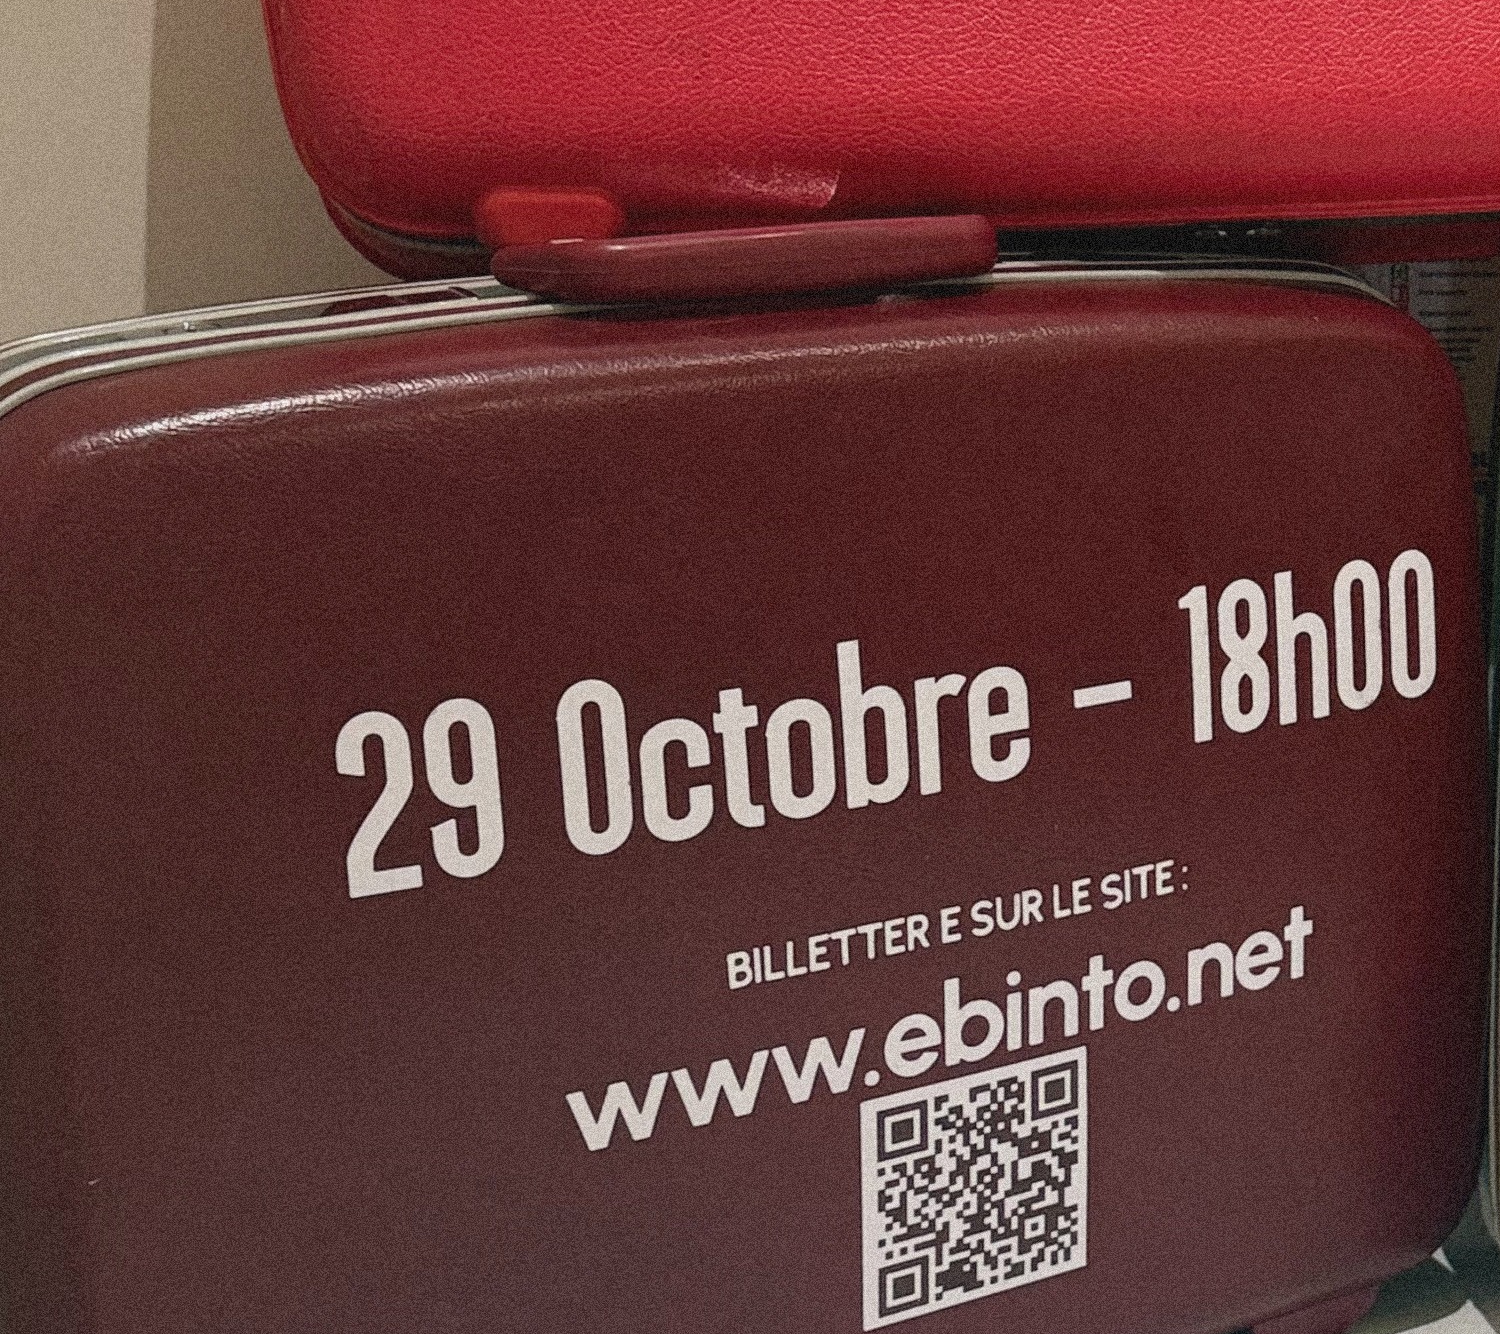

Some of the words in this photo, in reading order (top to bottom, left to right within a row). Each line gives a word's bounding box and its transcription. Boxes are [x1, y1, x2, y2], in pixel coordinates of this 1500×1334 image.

[336, 699, 504, 898] 29
[556, 640, 1030, 855] Octobre
[1179, 550, 1436, 742] 18h00
[566, 907, 1312, 1150] www.ebinto.net
[971, 890, 1043, 936] SUR
[1053, 878, 1091, 918] LE
